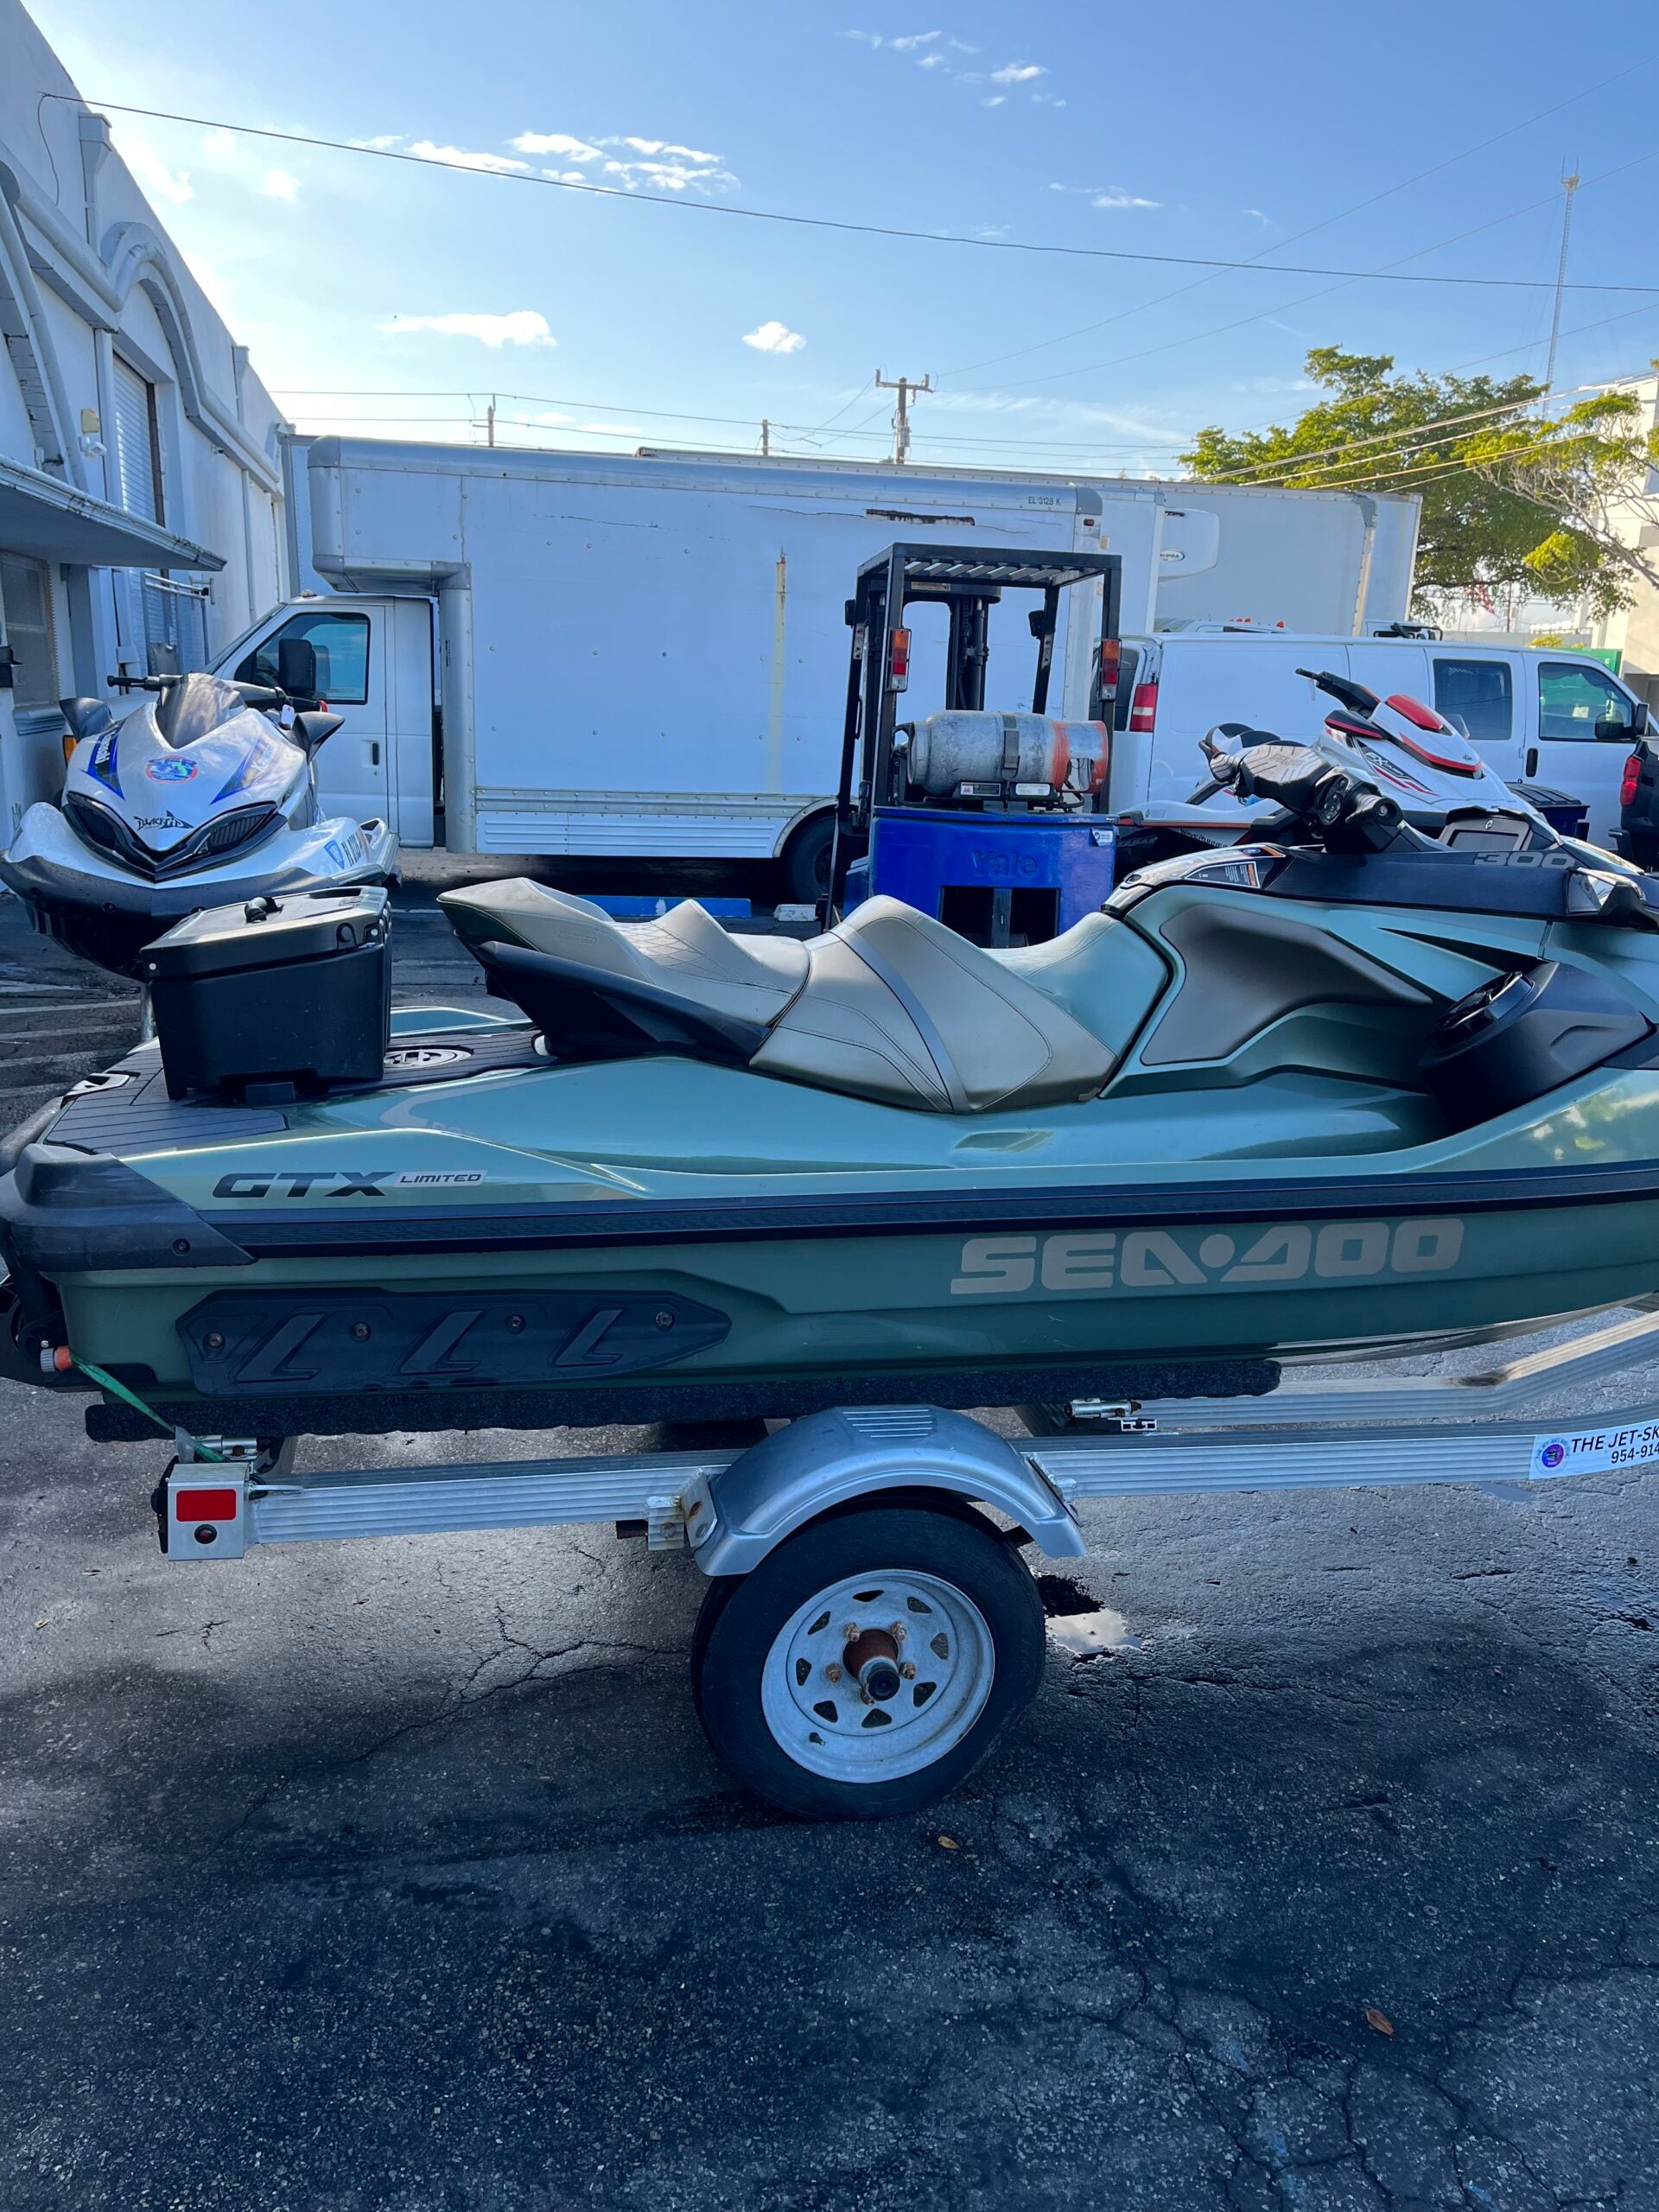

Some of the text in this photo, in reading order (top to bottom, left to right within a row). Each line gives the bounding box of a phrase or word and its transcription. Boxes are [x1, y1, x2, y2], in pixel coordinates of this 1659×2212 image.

[1028, 496, 1036, 505] EL
[1039, 497, 1054, 505] 3128
[971, 850, 1039, 878] Yale
[1474, 851, 1576, 868] 300
[213, 1172, 482, 1198] GTX LIMITED
[1572, 1435, 1605, 1453] THE
